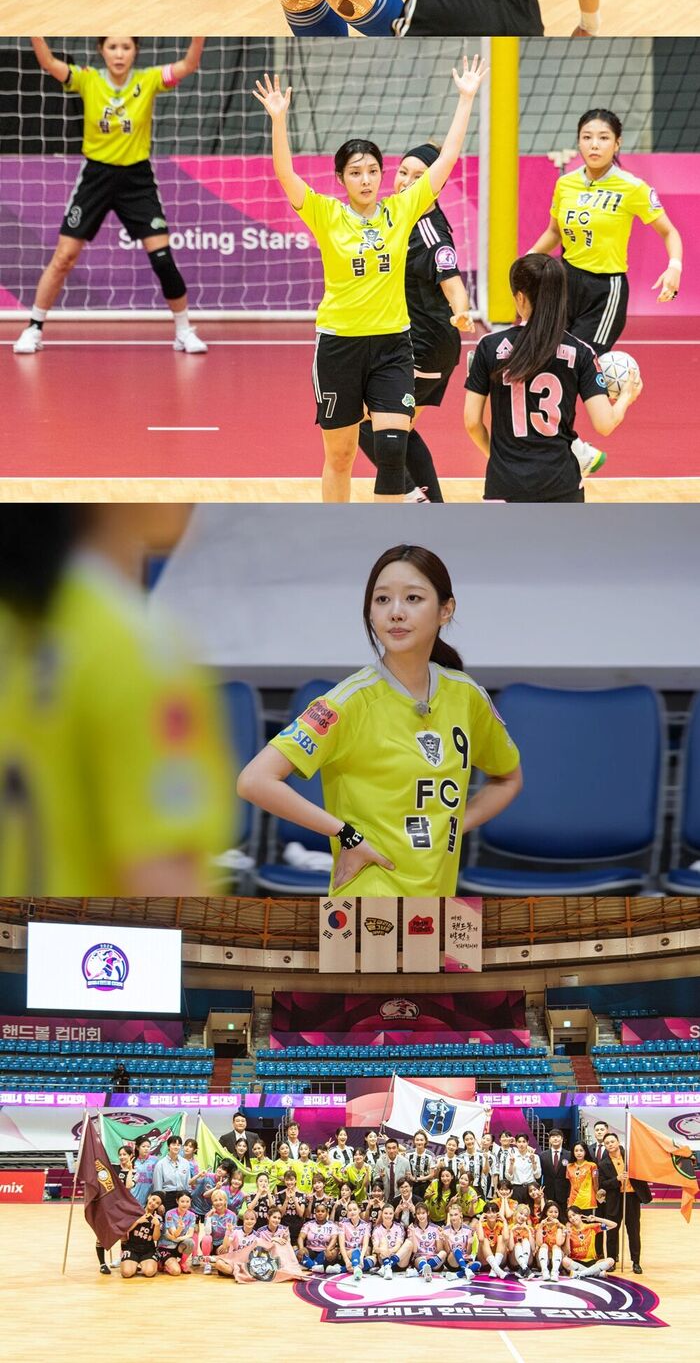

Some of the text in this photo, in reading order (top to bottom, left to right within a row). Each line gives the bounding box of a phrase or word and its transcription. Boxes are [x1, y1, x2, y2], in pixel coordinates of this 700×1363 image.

[104, 105, 126, 119] FC
[67, 205, 82, 228] 3
[566, 210, 590, 225] FC
[118, 226, 310, 255] Soting Stars
[322, 392, 337, 418] 7
[502, 369, 563, 438] 13
[306, 708, 330, 729] TUDIOS
[313, 700, 334, 720] PRISM
[293, 729, 318, 755] SBS
[452, 726, 469, 769] 9
[416, 779, 459, 809] FC
[2, 1024, 101, 1042] 핸드볼 컵대회
[303, 1095, 331, 1106] 골때녀
[335, 1307, 648, 1321] 골때녀 핸드볼 컵대회
